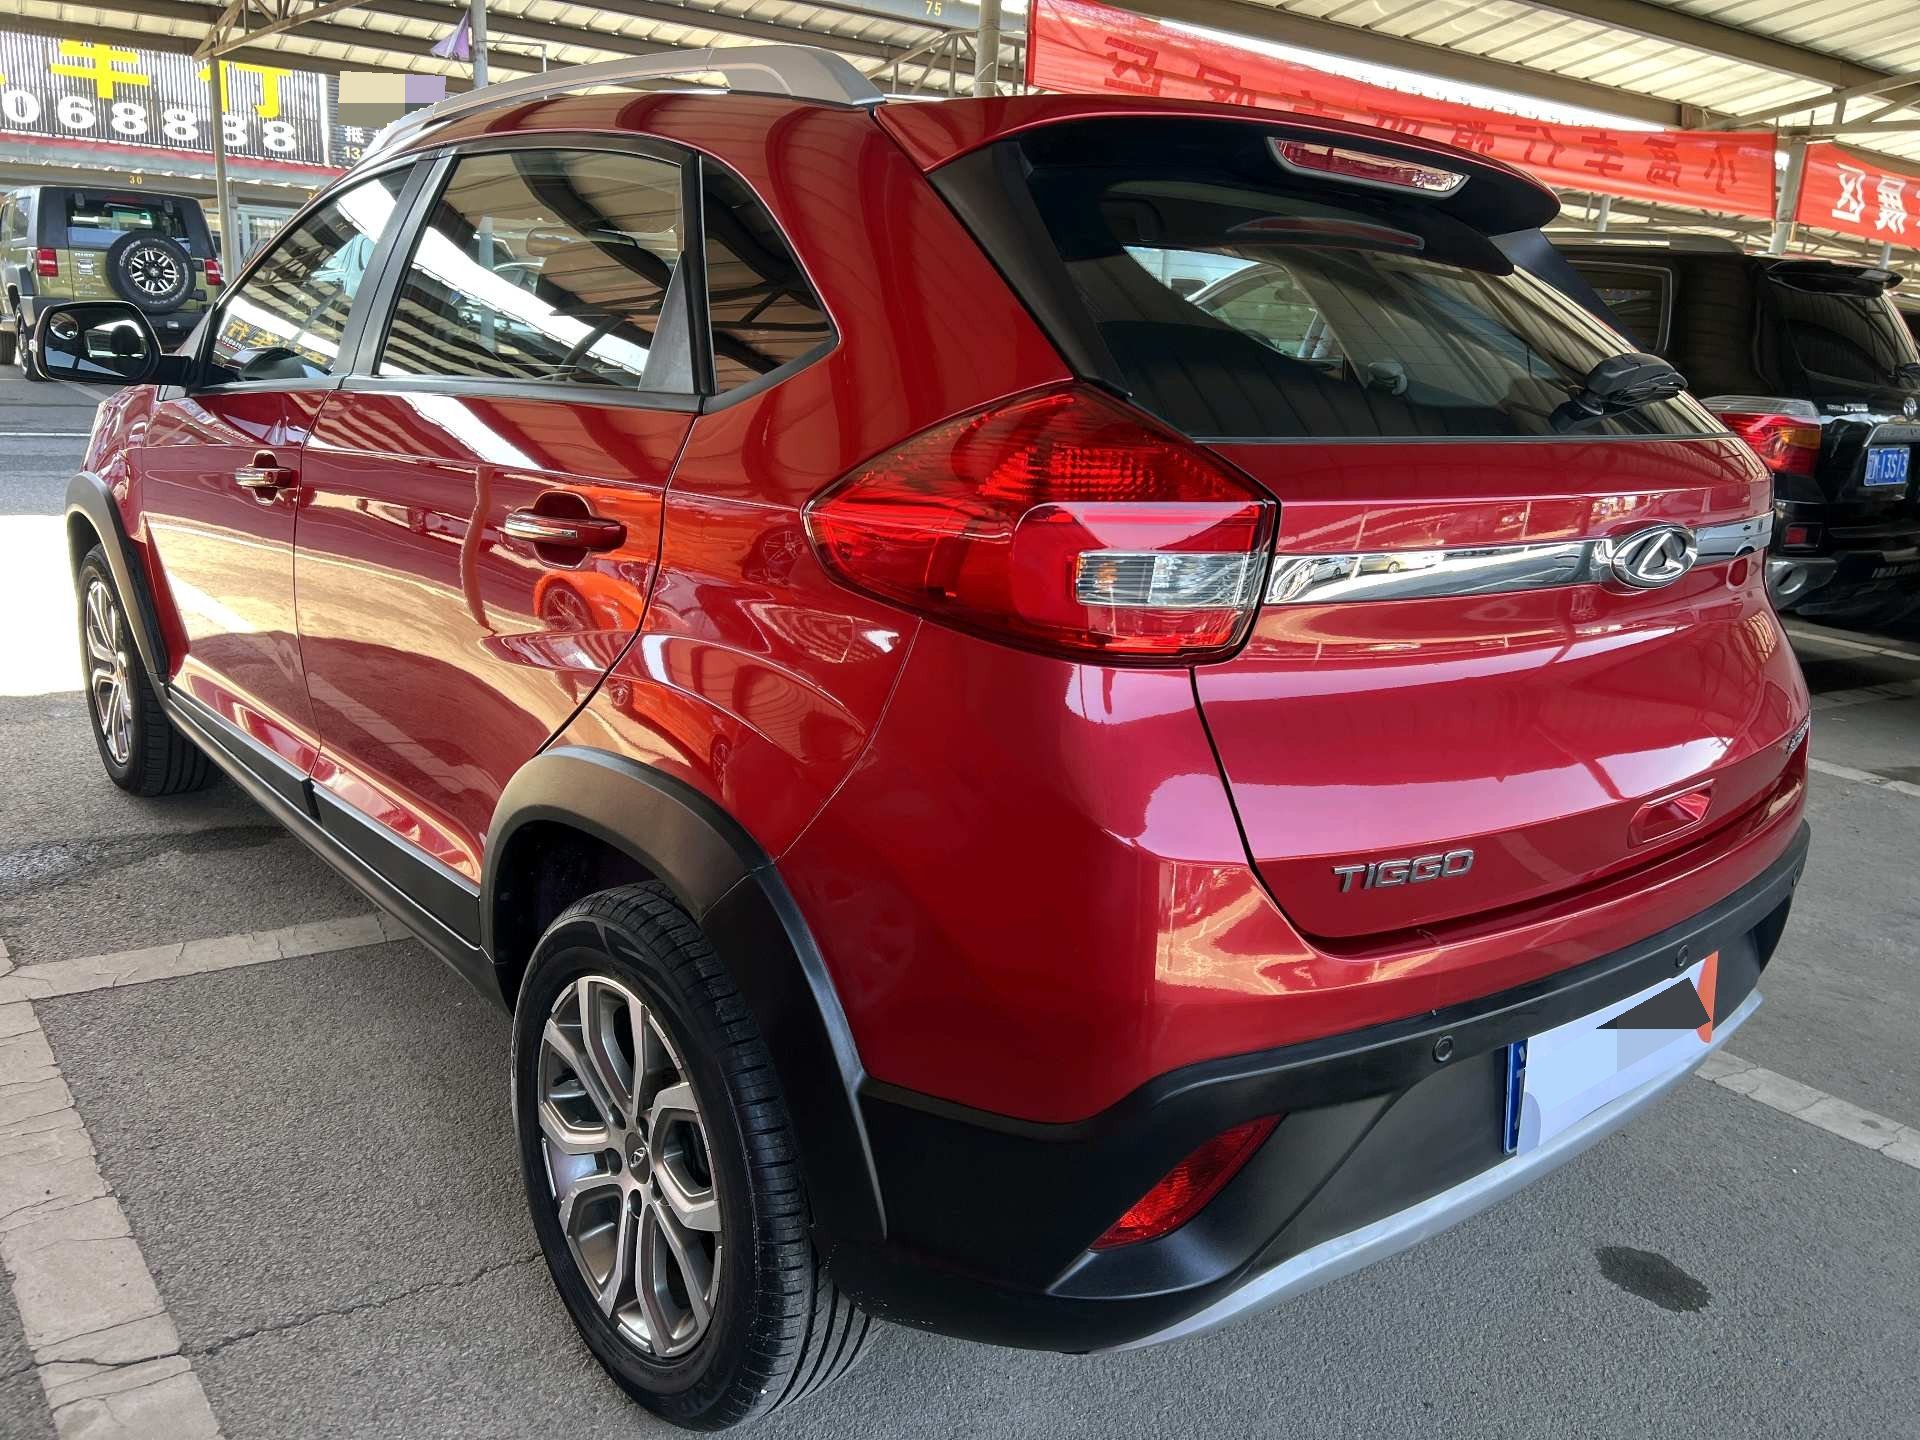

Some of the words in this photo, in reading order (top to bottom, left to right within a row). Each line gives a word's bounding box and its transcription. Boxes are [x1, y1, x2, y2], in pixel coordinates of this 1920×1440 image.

[925, 1, 942, 16] 75
[343, 145, 367, 160] 13
[128, 175, 143, 185] 30
[1333, 848, 1475, 894] TIGGO
